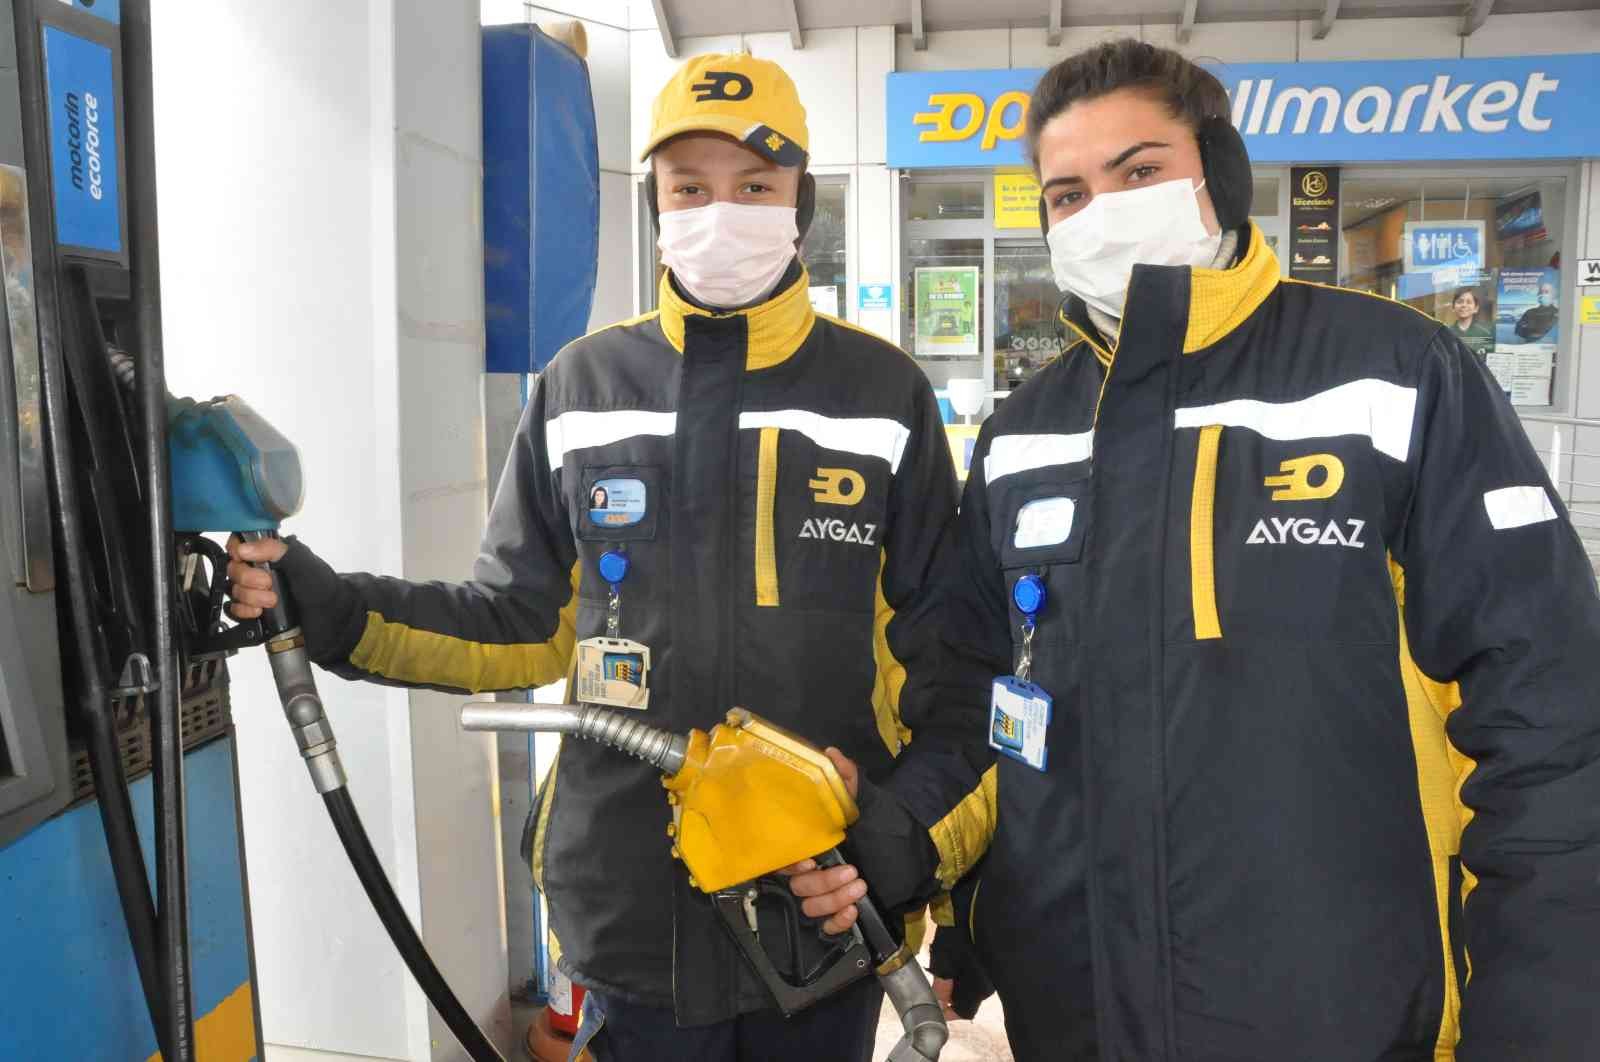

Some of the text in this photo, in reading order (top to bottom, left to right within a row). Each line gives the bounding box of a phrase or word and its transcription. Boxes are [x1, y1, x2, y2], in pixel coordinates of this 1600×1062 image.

[1225, 72, 1560, 134] llmarket
[64, 92, 83, 191] motorin
[85, 92, 102, 200] ecoforce
[799, 517, 877, 546] AYGAZ
[1245, 517, 1366, 549] AYGAZ
